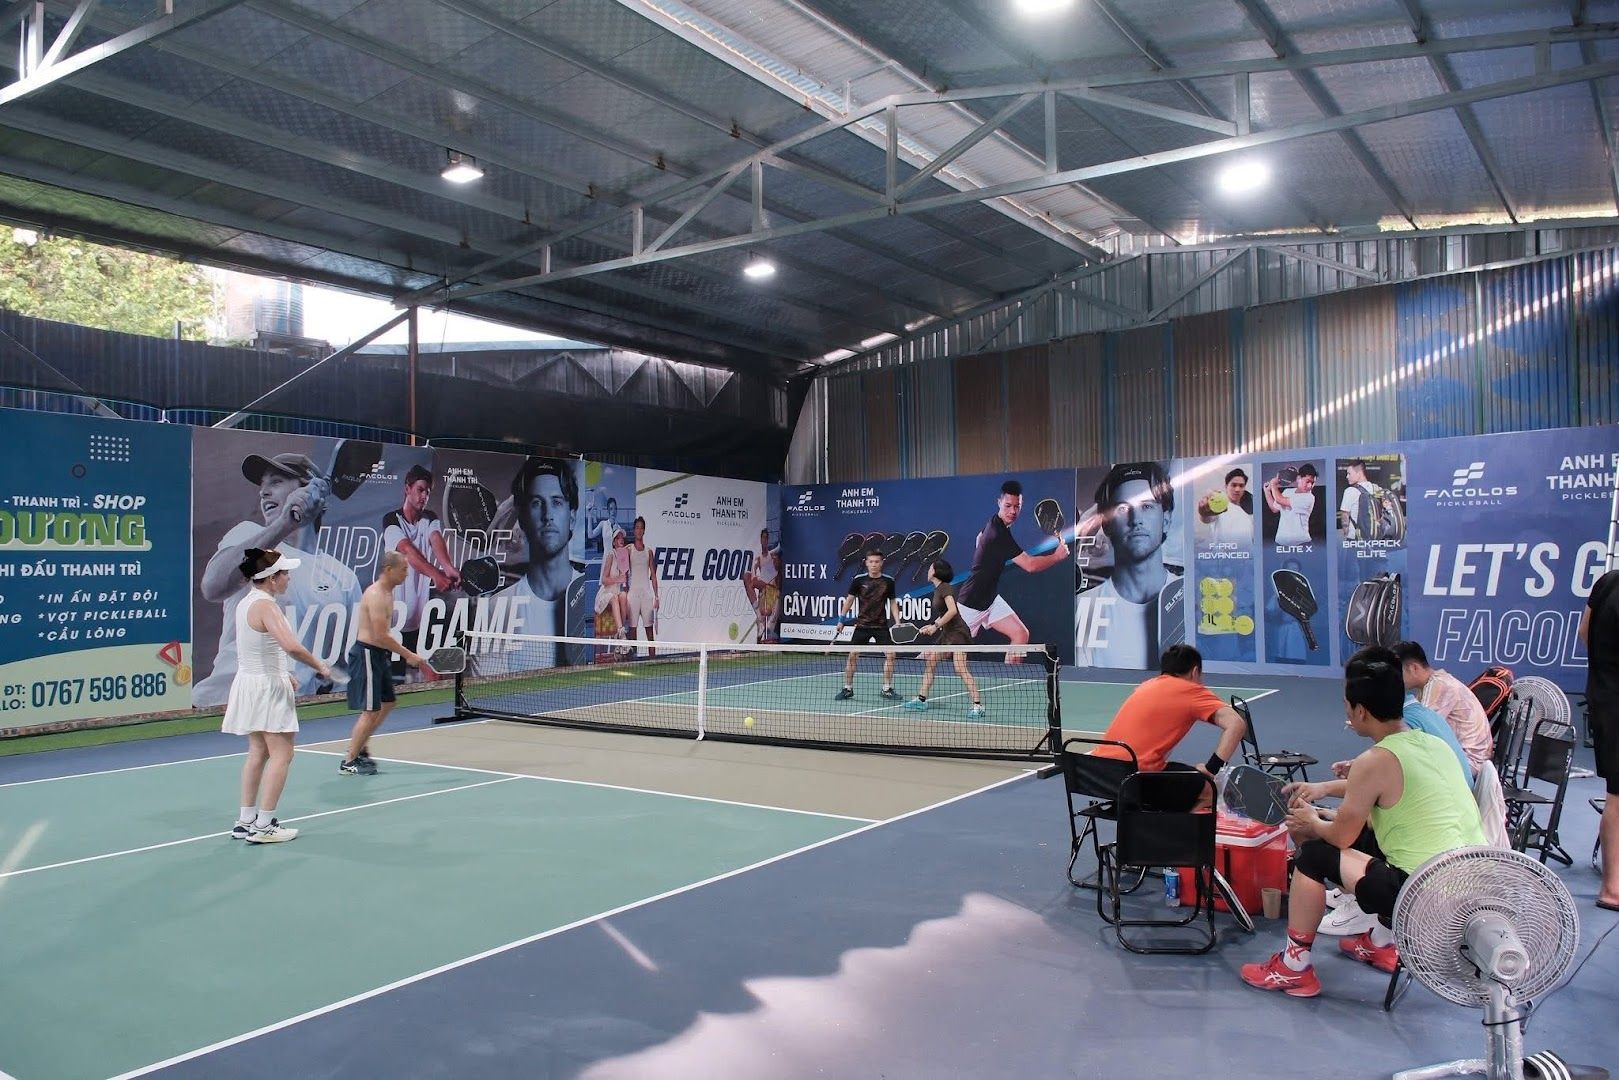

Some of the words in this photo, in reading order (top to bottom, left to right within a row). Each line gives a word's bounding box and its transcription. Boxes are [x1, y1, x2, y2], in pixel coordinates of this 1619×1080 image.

[1560, 454, 1604, 471] ANH
[1546, 472, 1616, 490] THANH
[841, 488, 859, 498] ANH
[861, 487, 874, 496] EM
[1424, 486, 1518, 499] FACOLOS
[12, 495, 58, 508] THANH
[62, 496, 81, 508] TRÌ
[92, 494, 146, 510] SHOP
[716, 496, 732, 506] ANH
[733, 497, 744, 507] EM
[836, 499, 864, 508] THANH
[865, 496, 880, 507] TRÌ
[661, 510, 701, 519] FACOLOS
[711, 508, 736, 519] THANH
[1209, 542, 1237, 550] F-PRO
[1276, 545, 1299, 553] ELITE
[1301, 545, 1312, 553] X
[1342, 539, 1400, 548] BACKPACK
[1198, 551, 1250, 560] ADVANCED
[1357, 550, 1387, 558] ELITE
[20, 558, 56, 577] ĐẤU
[61, 563, 115, 576] THANH
[119, 560, 142, 576] TRÌ
[651, 547, 695, 581] FEEL
[701, 548, 754, 581] GOOD
[1423, 541, 1560, 598] LET'S
[785, 563, 816, 579] ELITE
[820, 564, 827, 579] X
[70, 589, 92, 603] ẤN
[98, 590, 127, 604] ĐẶT
[132, 589, 158, 603] ĐỘI
[783, 591, 809, 616] CÂY
[810, 595, 836, 621] VỢT
[84, 608, 168, 621] PICKLEBALL
[86, 626, 127, 639] LÔNG
[416, 595, 531, 659] GAME
[1434, 608, 1588, 668] FACOL
[4, 684, 26, 696] ĐT:
[32, 678, 85, 707] 0767
[90, 675, 127, 703] 596
[131, 672, 167, 698] 886
[0, 699, 26, 711] LO:
